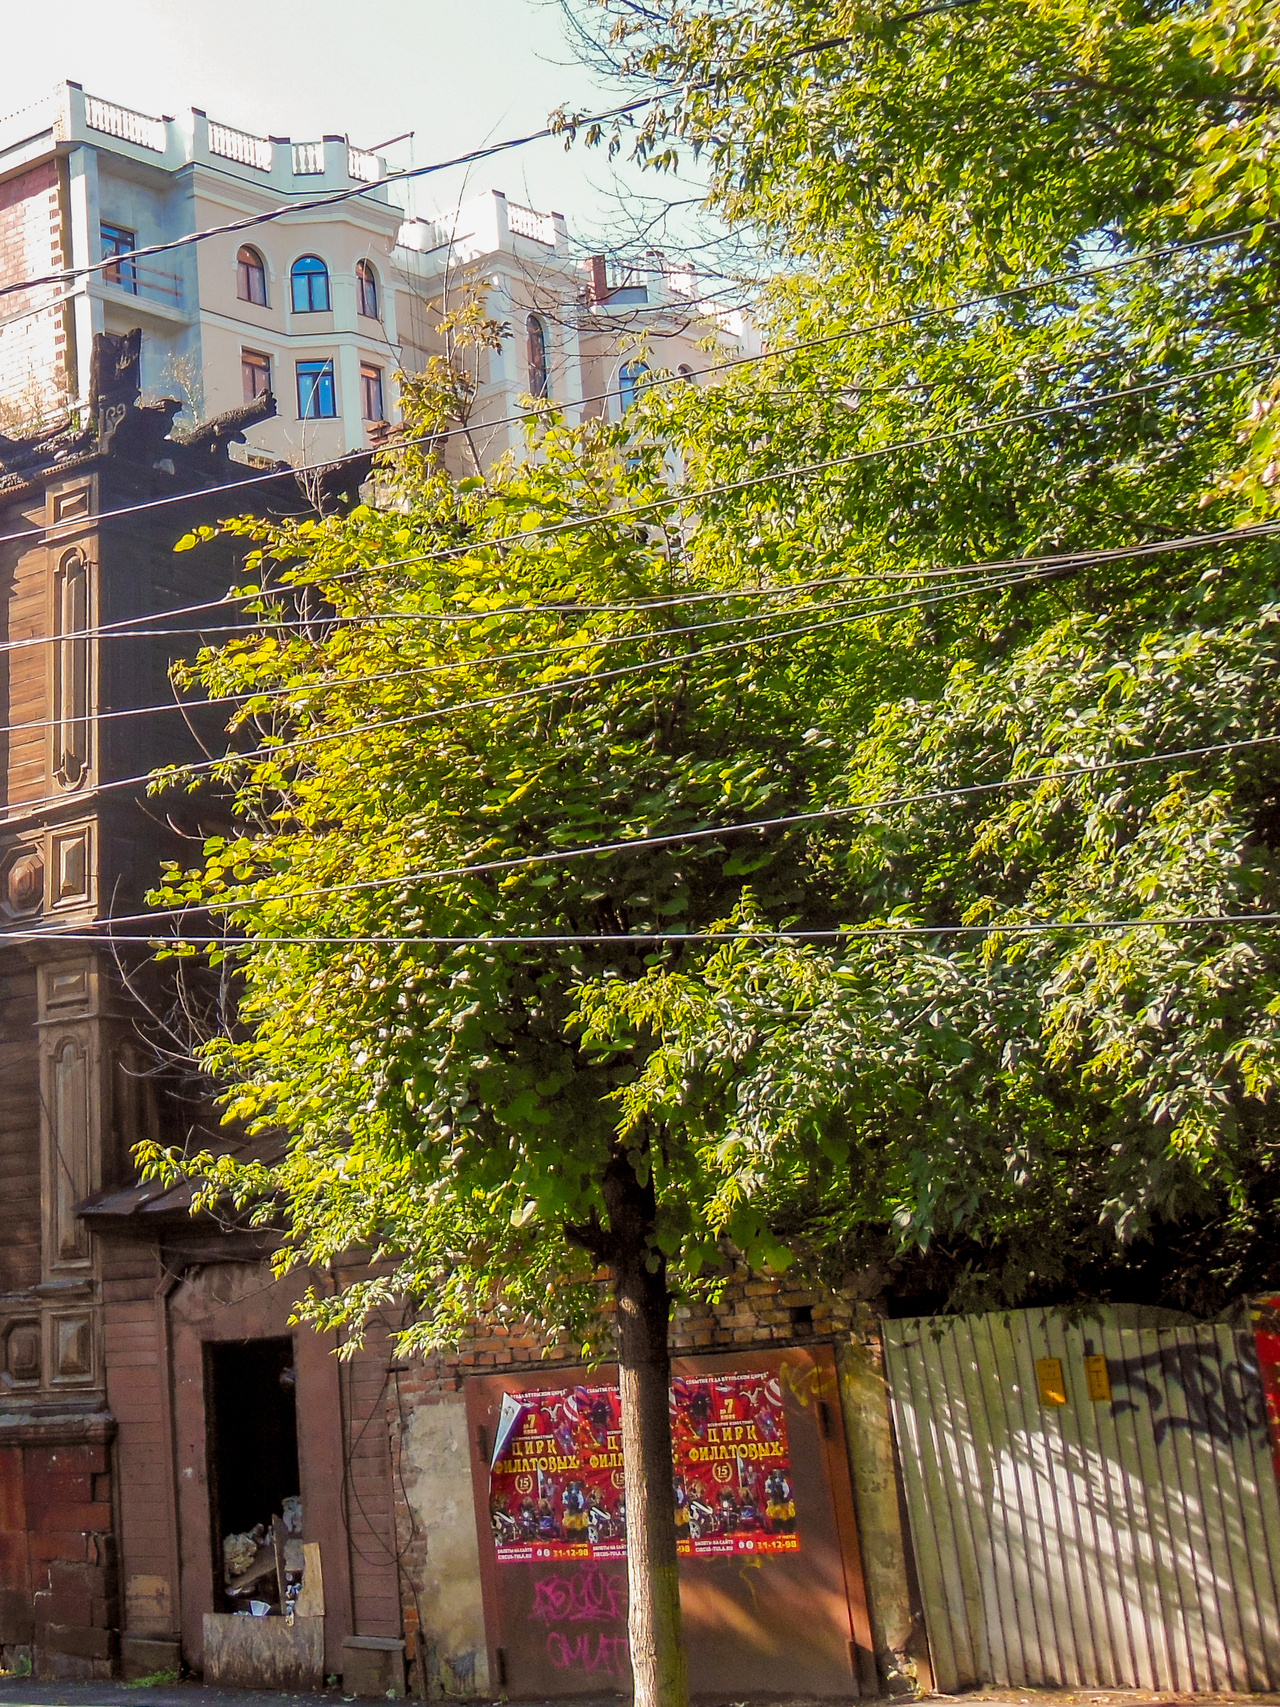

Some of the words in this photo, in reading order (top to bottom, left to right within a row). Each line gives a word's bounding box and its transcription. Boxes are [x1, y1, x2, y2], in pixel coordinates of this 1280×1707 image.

[724, 1398, 733, 1414] 7
[527, 1414, 536, 1427] 7
[707, 1424, 758, 1443] ЦИРК
[512, 1438, 557, 1456] ЦИРК
[689, 1441, 784, 1461] ФИЛАТОВЫХ
[494, 1455, 580, 1474] ФИЛАТОВЫХ
[717, 1465, 728, 1475] 15
[520, 1477, 529, 1487] 15
